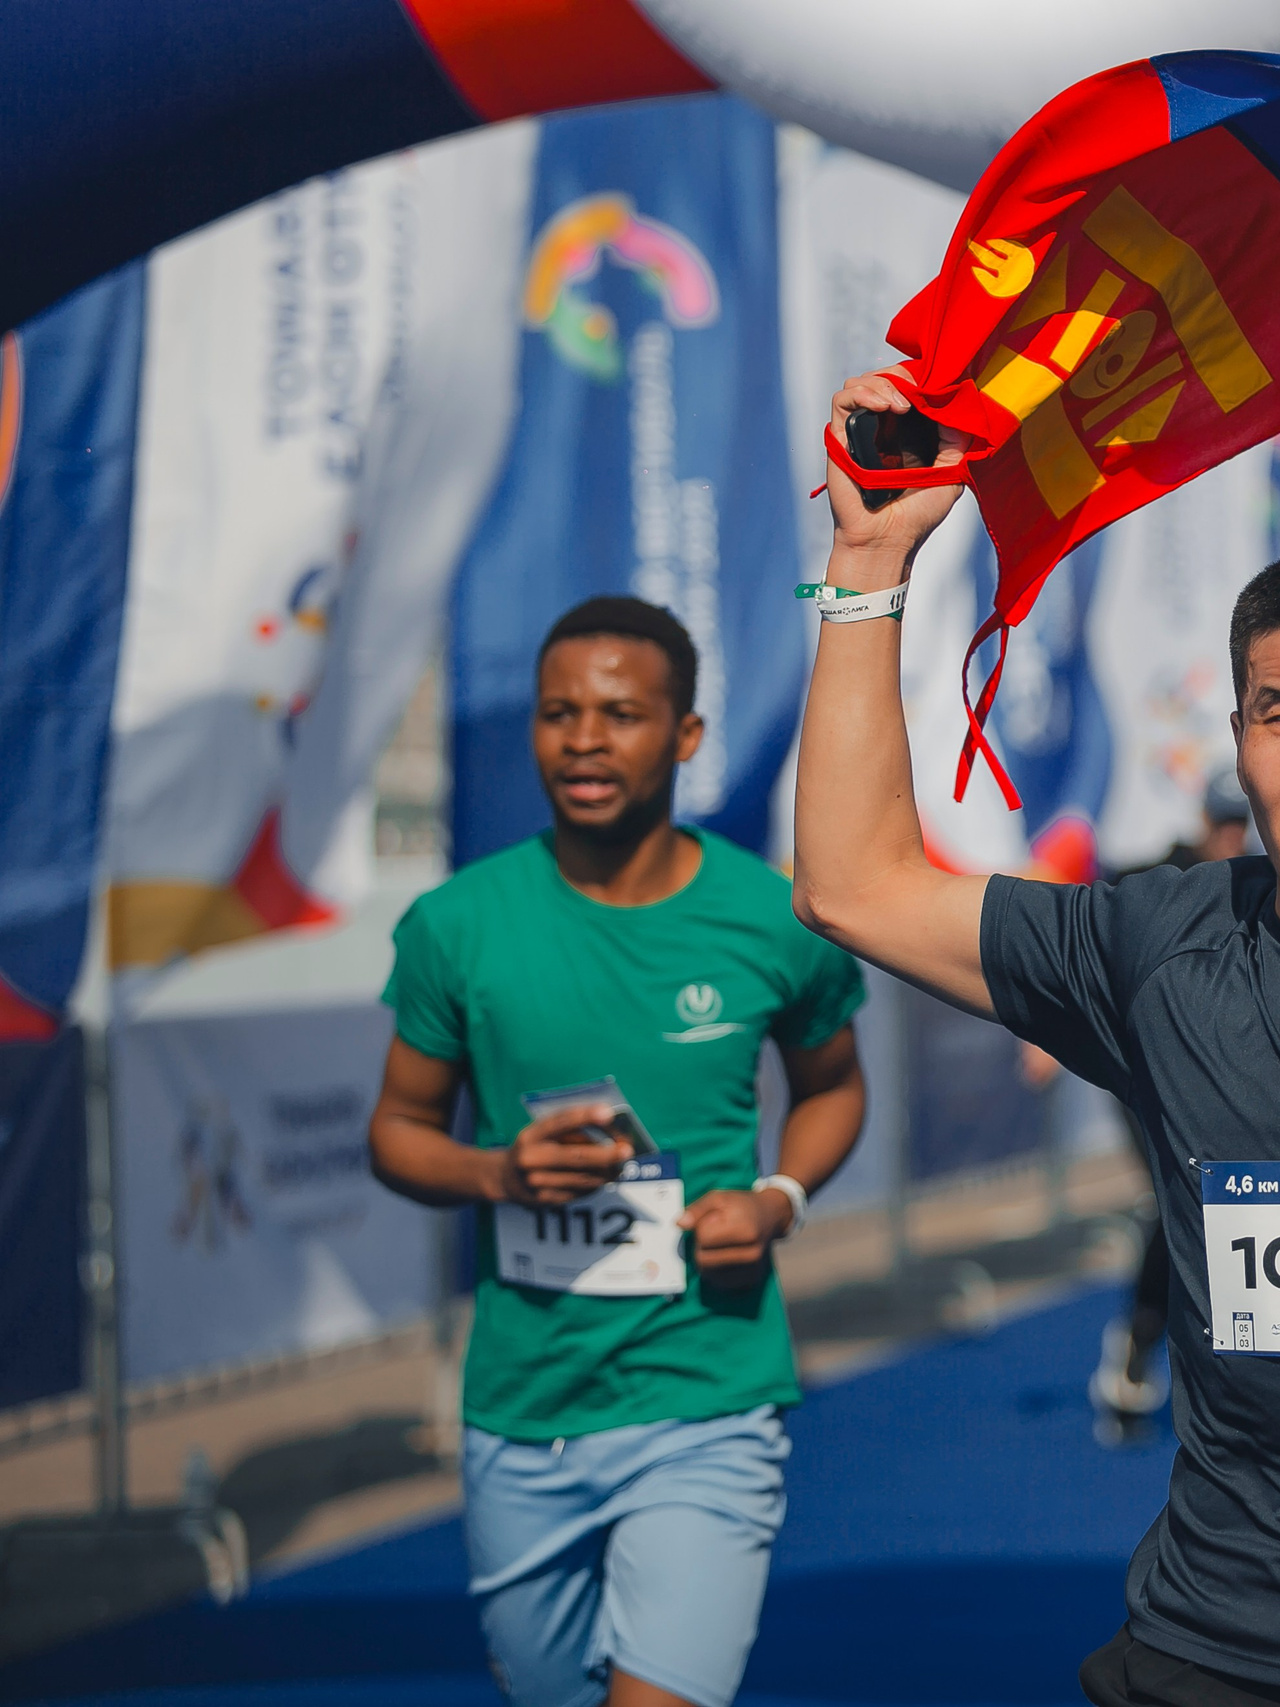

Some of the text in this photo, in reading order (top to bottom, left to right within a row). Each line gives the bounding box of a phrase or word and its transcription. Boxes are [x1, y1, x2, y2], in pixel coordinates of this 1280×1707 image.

[1225, 1175, 1254, 1196] 4,6
[530, 1206, 638, 1245] 1112
[1239, 1324, 1249, 1332] 05
[1239, 1339, 1250, 1348] 03
